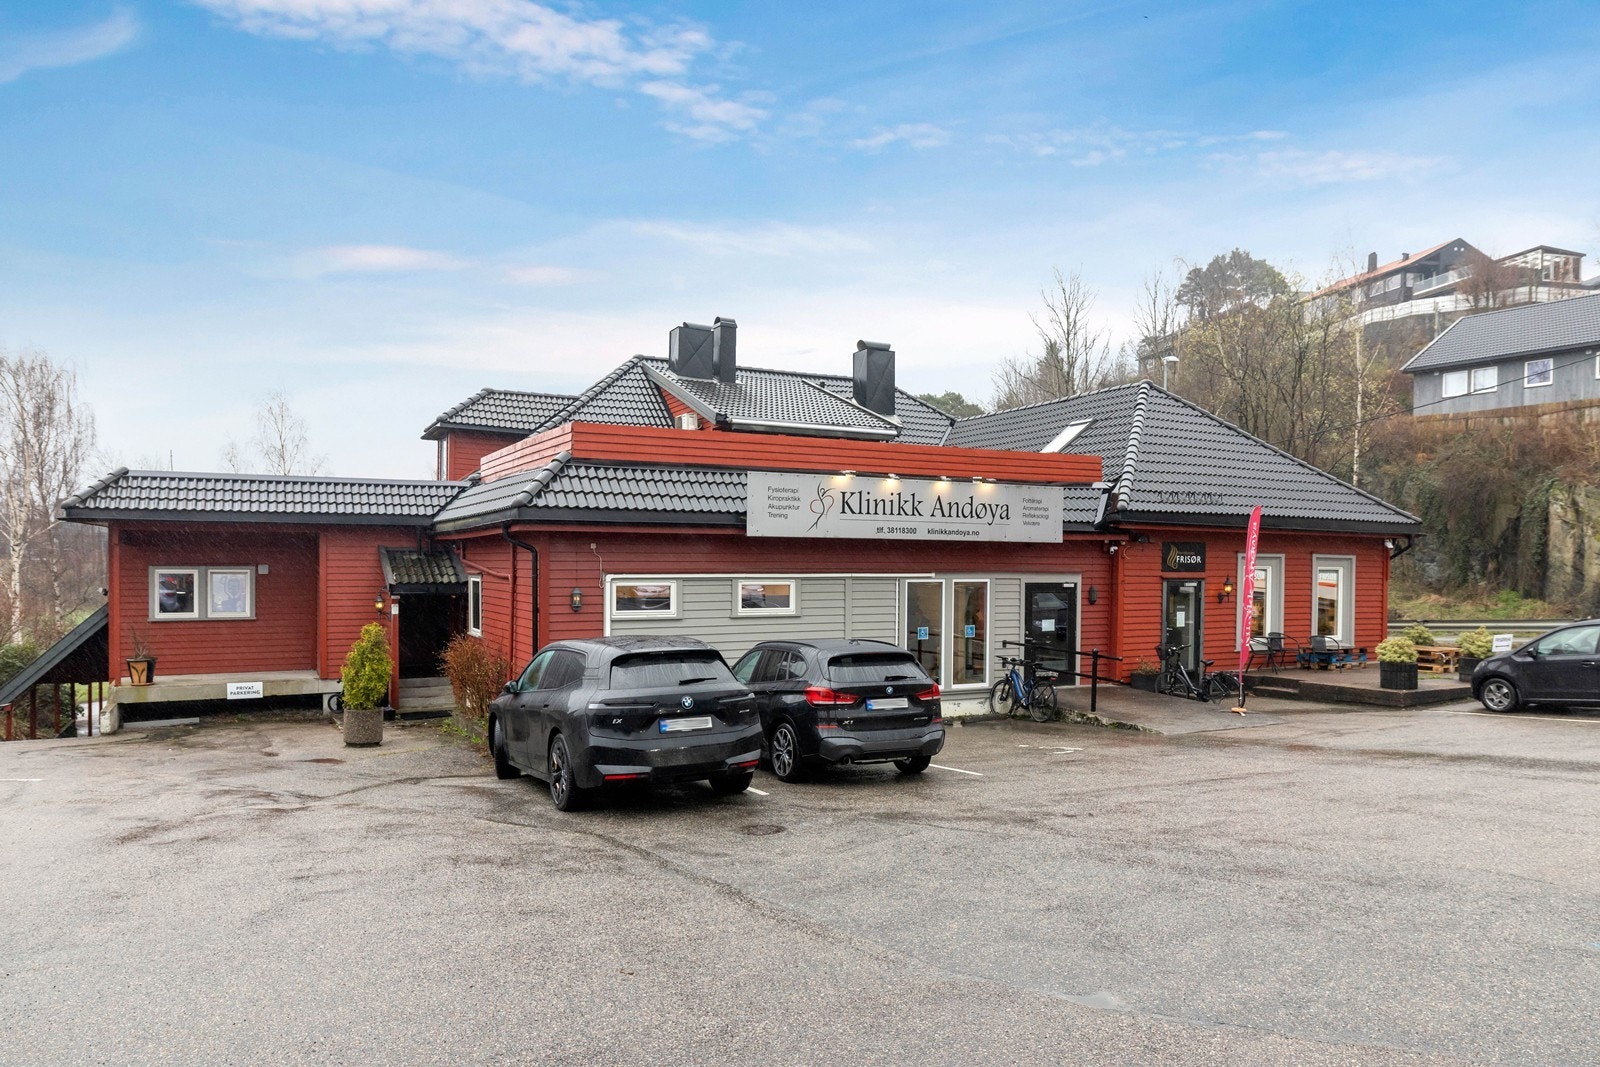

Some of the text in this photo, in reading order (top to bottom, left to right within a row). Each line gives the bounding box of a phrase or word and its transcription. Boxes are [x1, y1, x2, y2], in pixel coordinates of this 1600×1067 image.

[767, 485, 799, 493] Fysioterapi
[767, 503, 800, 511] Akupunktur
[840, 490, 1011, 526] Klinikk Andøya
[767, 511, 788, 520] Trening
[887, 527, 917, 535] 38118300
[927, 528, 980, 537] klinikkandoya.no
[1176, 555, 1202, 564] FRISØR
